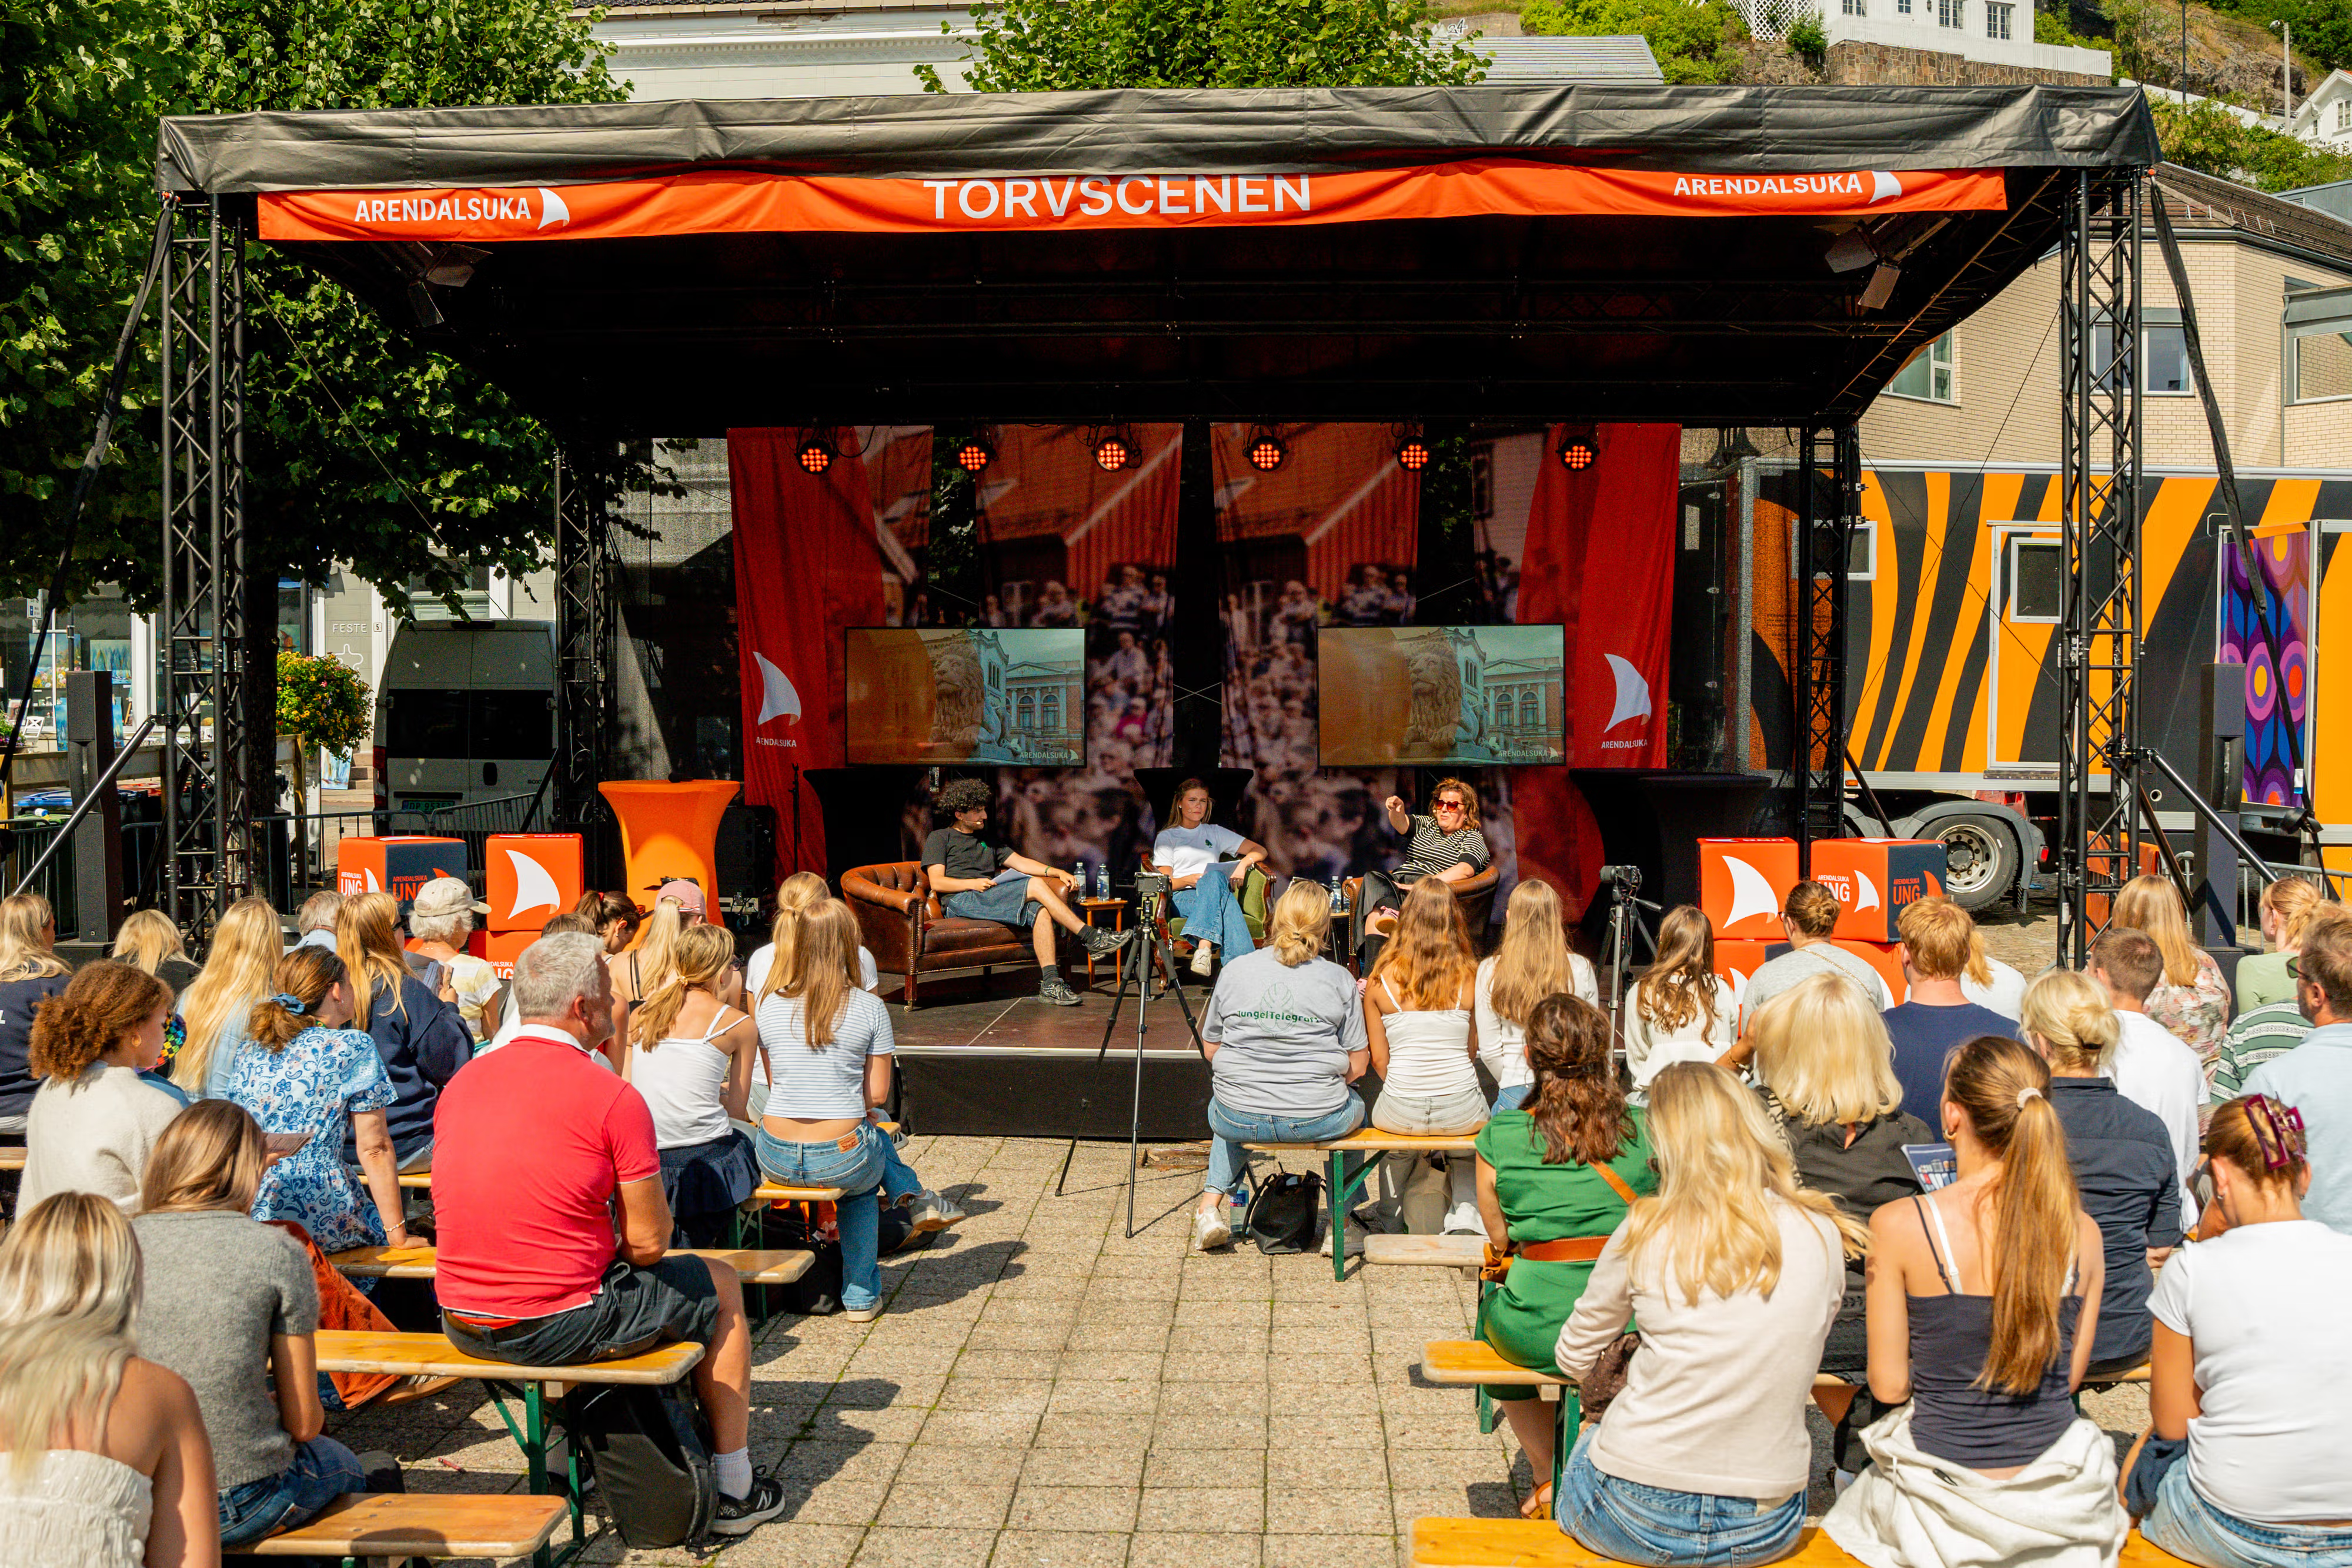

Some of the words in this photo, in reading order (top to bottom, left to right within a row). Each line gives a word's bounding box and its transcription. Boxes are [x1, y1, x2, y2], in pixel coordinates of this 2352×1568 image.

[1673, 173, 1863, 196] ARENDALSUKA
[923, 174, 1311, 219] TORVSCENEN
[355, 198, 532, 222] ARENDALSUKA
[332, 623, 368, 633] FESTE
[1601, 738, 1648, 748] ARENDALSUKA
[340, 878, 362, 897] UNG
[1818, 882, 1850, 902] NG
[1893, 884, 1920, 905] UNG
